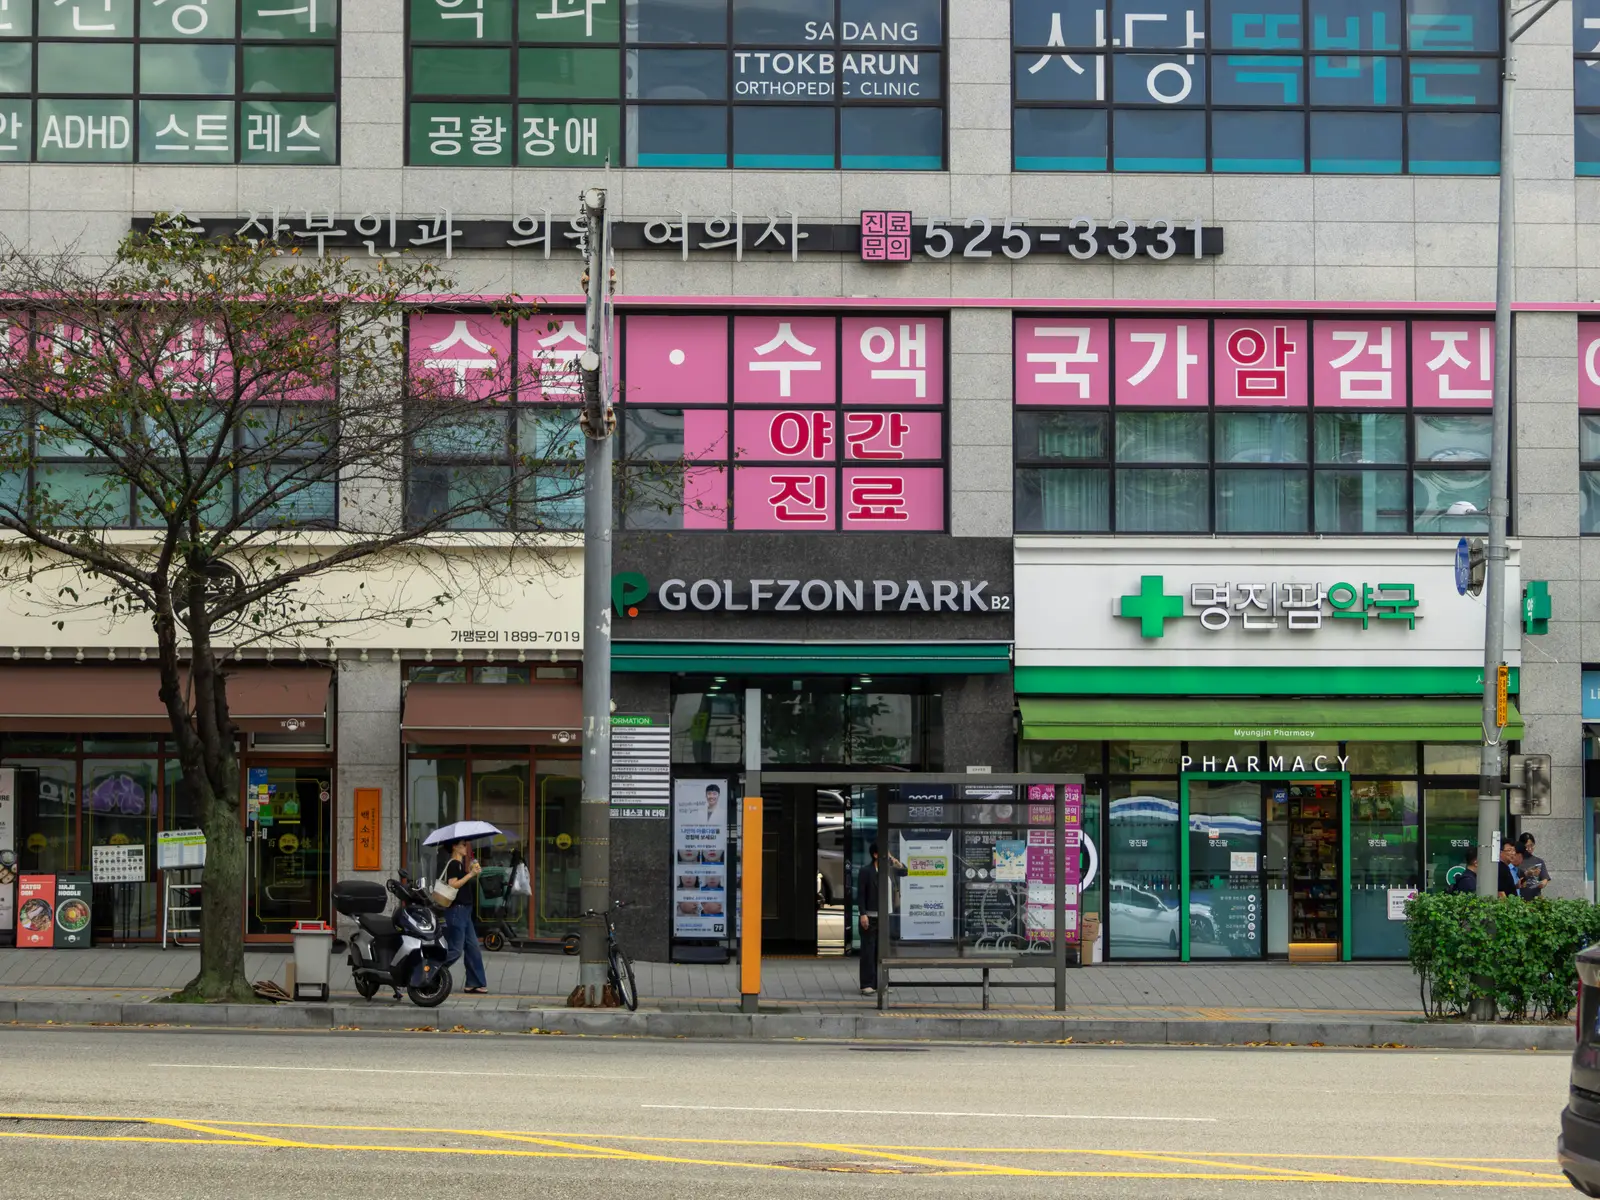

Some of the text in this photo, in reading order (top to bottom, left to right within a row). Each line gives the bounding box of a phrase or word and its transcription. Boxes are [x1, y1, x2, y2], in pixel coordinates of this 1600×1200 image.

[804, 21, 919, 42] SADANG
[735, 53, 919, 75] TTOKBARUN
[1028, 9, 1205, 104] 사당
[735, 81, 920, 97] ORTHOPEDIC CLINIC
[41, 115, 131, 149] ADHD
[154, 113, 321, 153] 스트레스
[235, 204, 463, 260] 산부인과
[643, 209, 810, 263] 여의사
[864, 215, 909, 236] 진료
[923, 213, 1204, 260] 525-3331
[863, 237, 909, 259] 문의
[748, 322, 928, 398] 수액
[768, 410, 911, 461] 야간
[767, 473, 911, 524] 진료
[658, 578, 1010, 612] GOLFZON PARK B2
[450, 630, 580, 643] 가맹문의 1899-7019
[1233, 728, 1316, 739] Myungjin Pharmacy
[1180, 755, 1350, 772] PHARMACY
